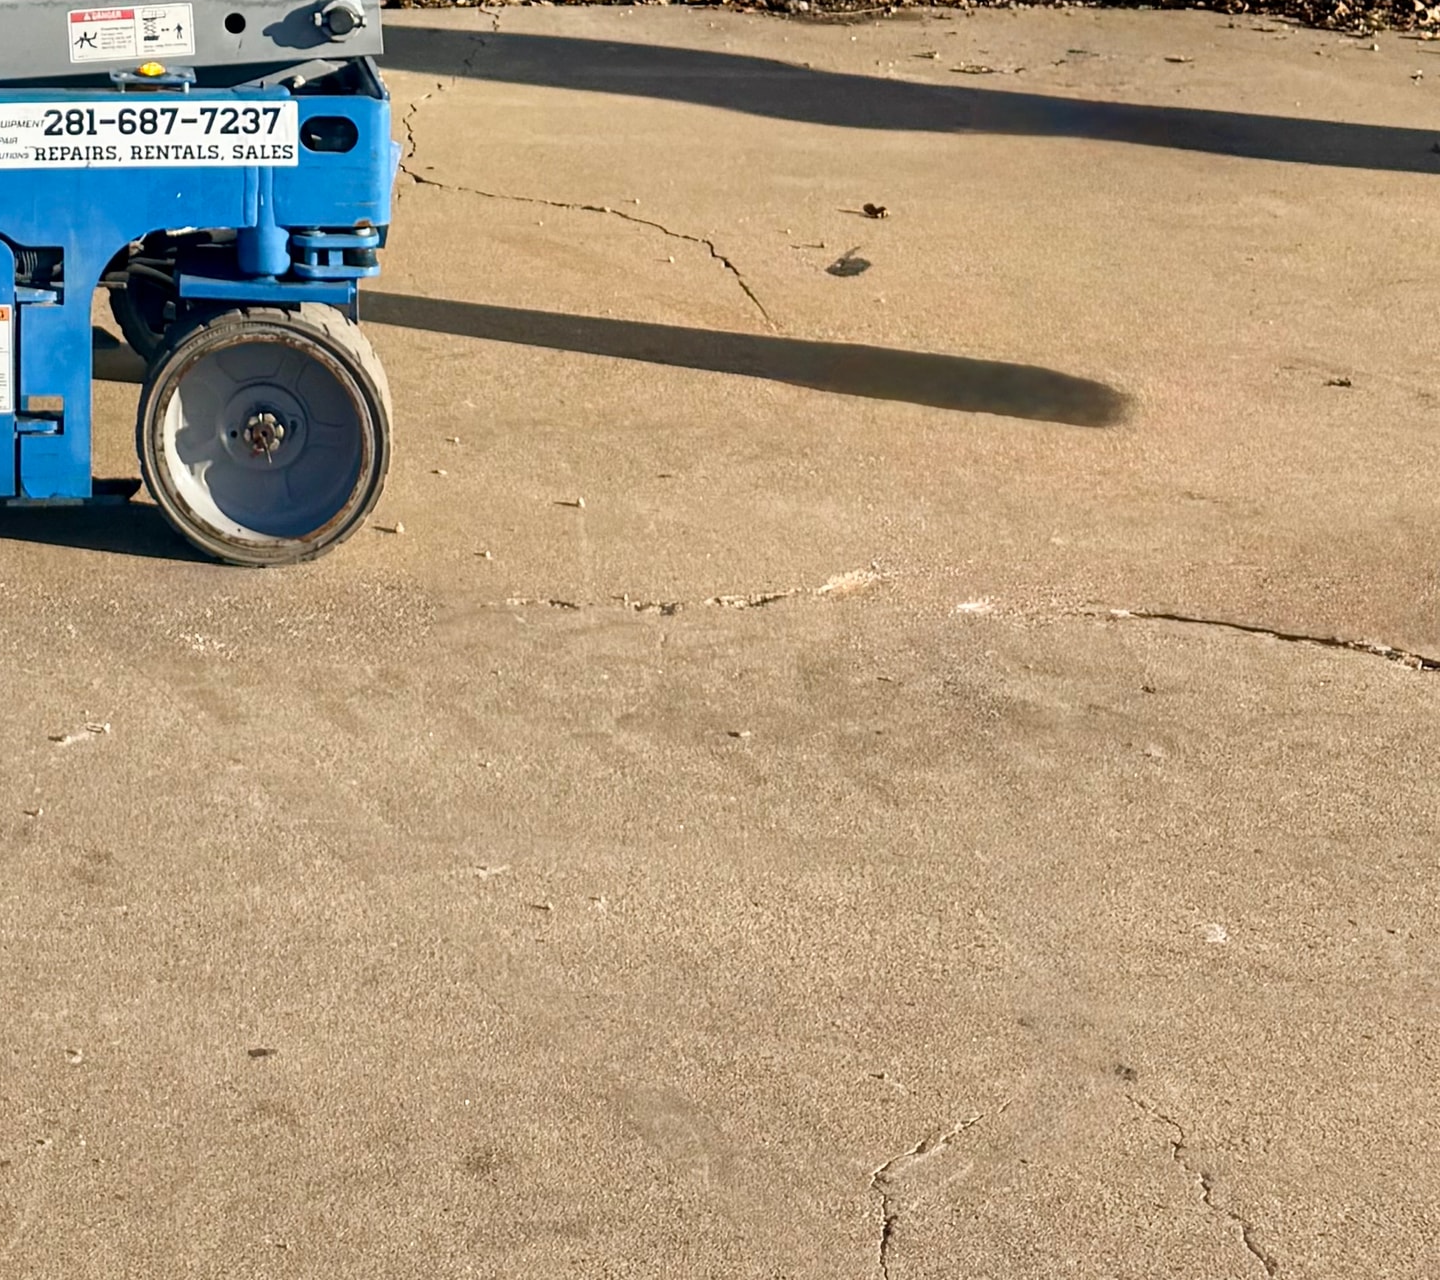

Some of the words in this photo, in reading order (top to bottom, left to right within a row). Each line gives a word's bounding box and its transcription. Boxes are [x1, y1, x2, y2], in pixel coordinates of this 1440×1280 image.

[44, 109, 282, 136] 281-687-7237
[34, 145, 122, 161] REPAIRS,
[130, 145, 224, 161] RENTALS,
[233, 144, 294, 160] SALES
